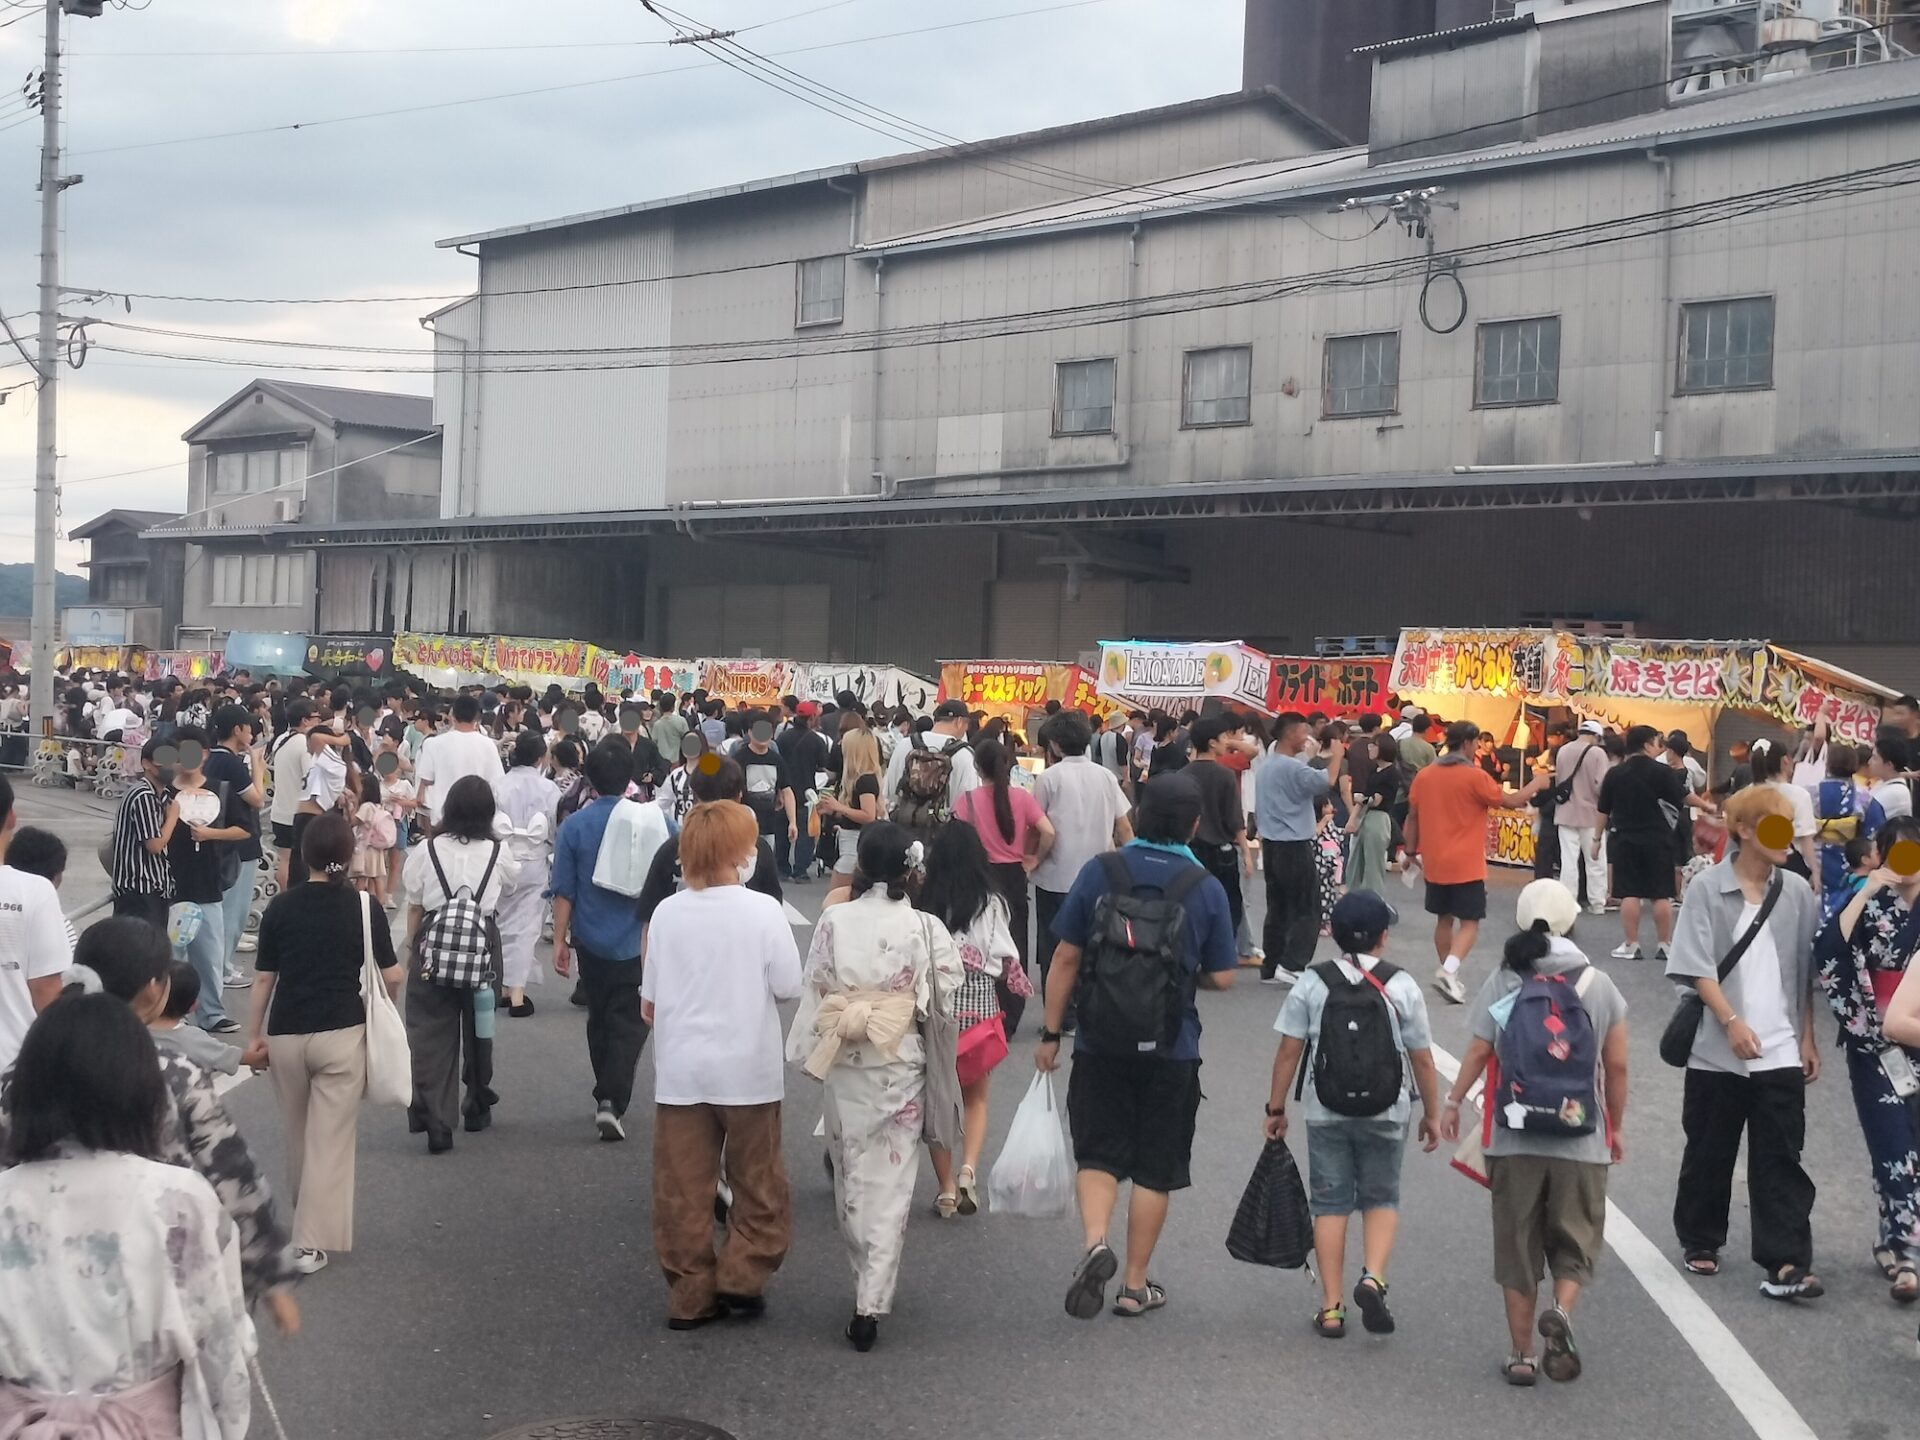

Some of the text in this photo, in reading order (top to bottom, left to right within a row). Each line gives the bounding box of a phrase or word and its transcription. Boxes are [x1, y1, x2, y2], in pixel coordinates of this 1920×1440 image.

[713, 665, 769, 695] Churros
[1123, 649, 1207, 692] LEMONADE
[1276, 663, 1380, 707] フライド ポテト
[1610, 659, 1721, 697] 焼きそば
[1798, 686, 1880, 742] 焼きそば
